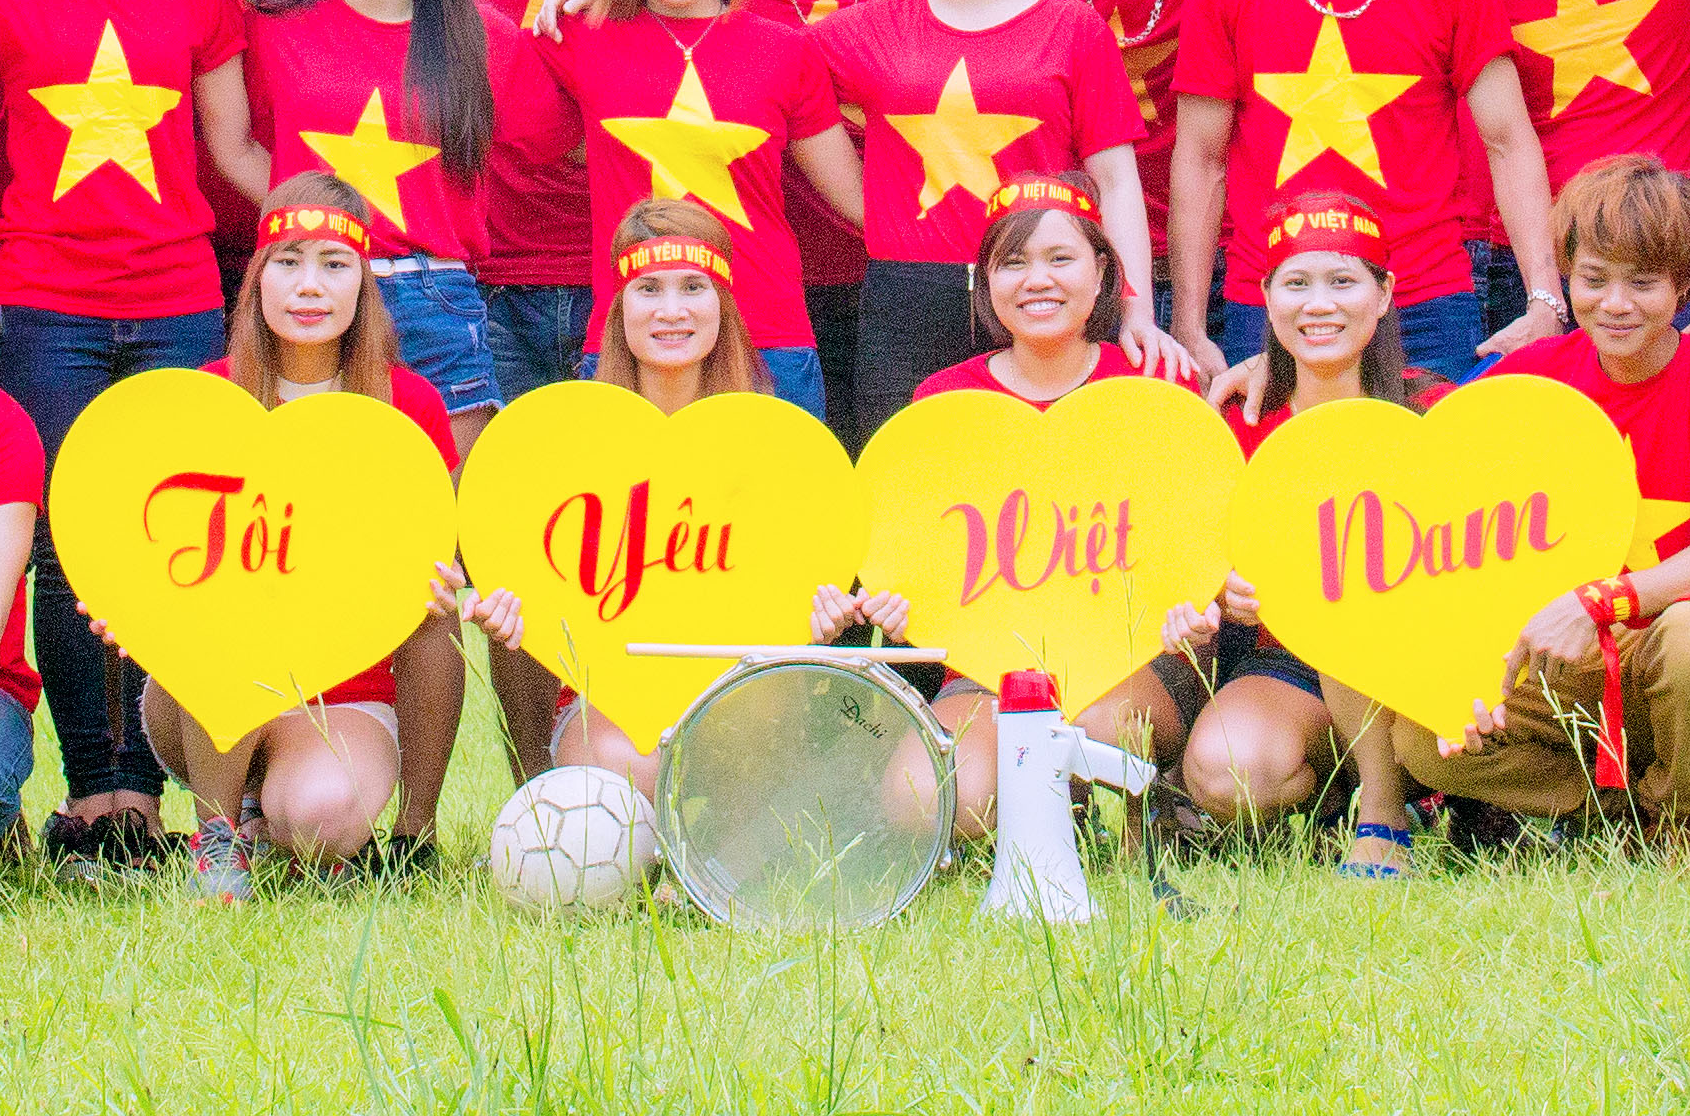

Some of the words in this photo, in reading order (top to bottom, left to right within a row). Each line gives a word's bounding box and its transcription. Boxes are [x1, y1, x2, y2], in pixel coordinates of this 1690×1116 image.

[1023, 180, 1046, 201] VIỆT
[1048, 184, 1072, 203] NAM
[285, 212, 295, 229] I
[1308, 209, 1349, 233] VIỆT
[1353, 215, 1381, 239] NAM
[631, 247, 650, 270] TÔI
[653, 241, 682, 262] YÊU
[685, 245, 712, 268] VIỆT
[143, 471, 298, 587] Tôi
[543, 478, 736, 623] Yêu
[1317, 489, 1567, 603] Nam
